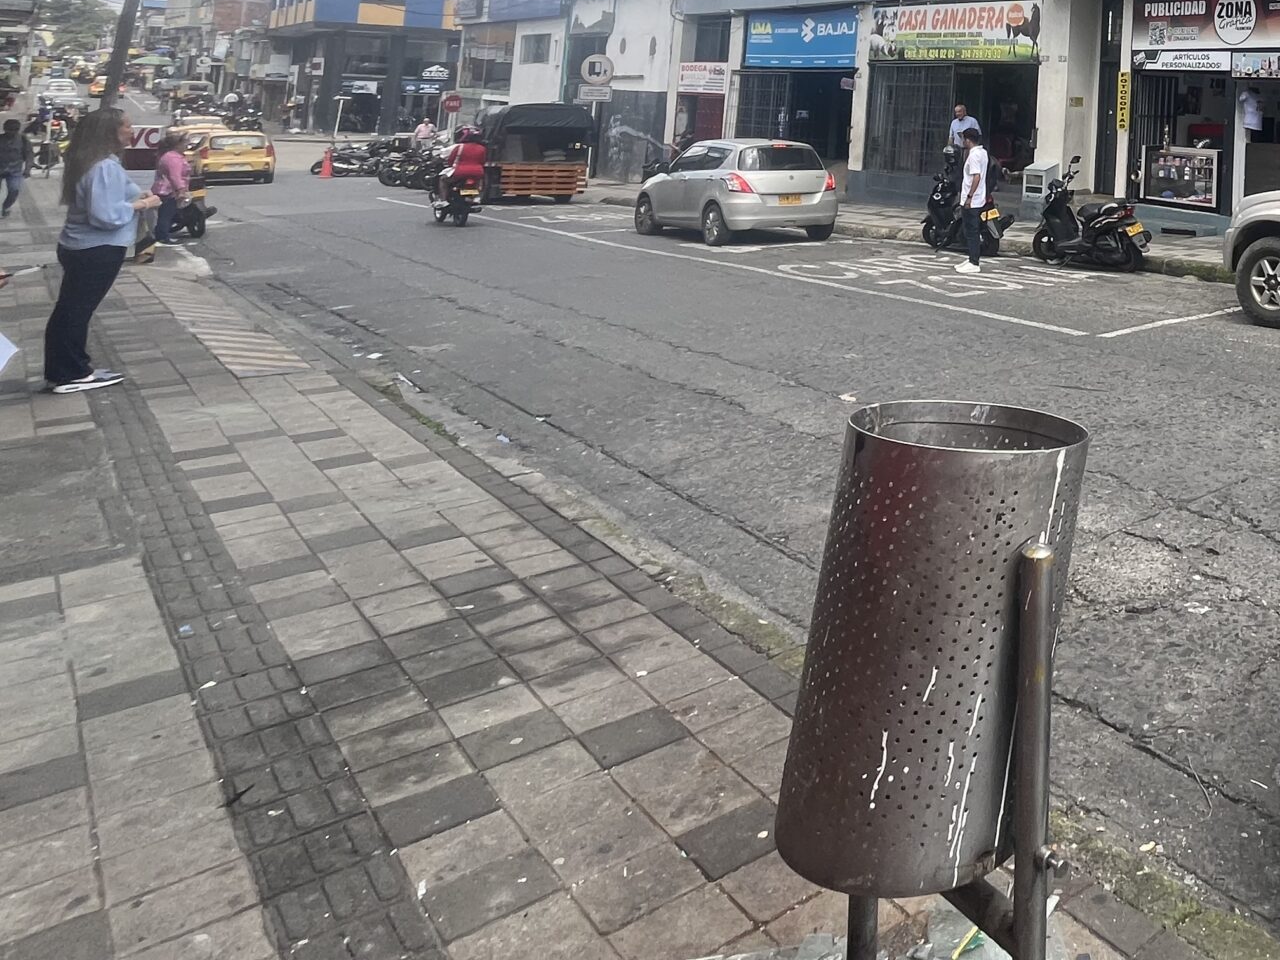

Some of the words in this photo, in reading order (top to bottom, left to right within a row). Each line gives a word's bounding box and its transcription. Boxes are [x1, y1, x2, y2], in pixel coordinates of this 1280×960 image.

[1144, 0, 1206, 17] PUBLICIDAD
[1217, 1, 1252, 19] ZONA
[898, 9, 927, 31] CASA
[931, 6, 1004, 31] GANADERA
[817, 21, 856, 36] BAJAJ
[1161, 61, 1222, 69] PERSONALIZADOS!
[1119, 72, 1128, 129] FOTOCOPIAS
